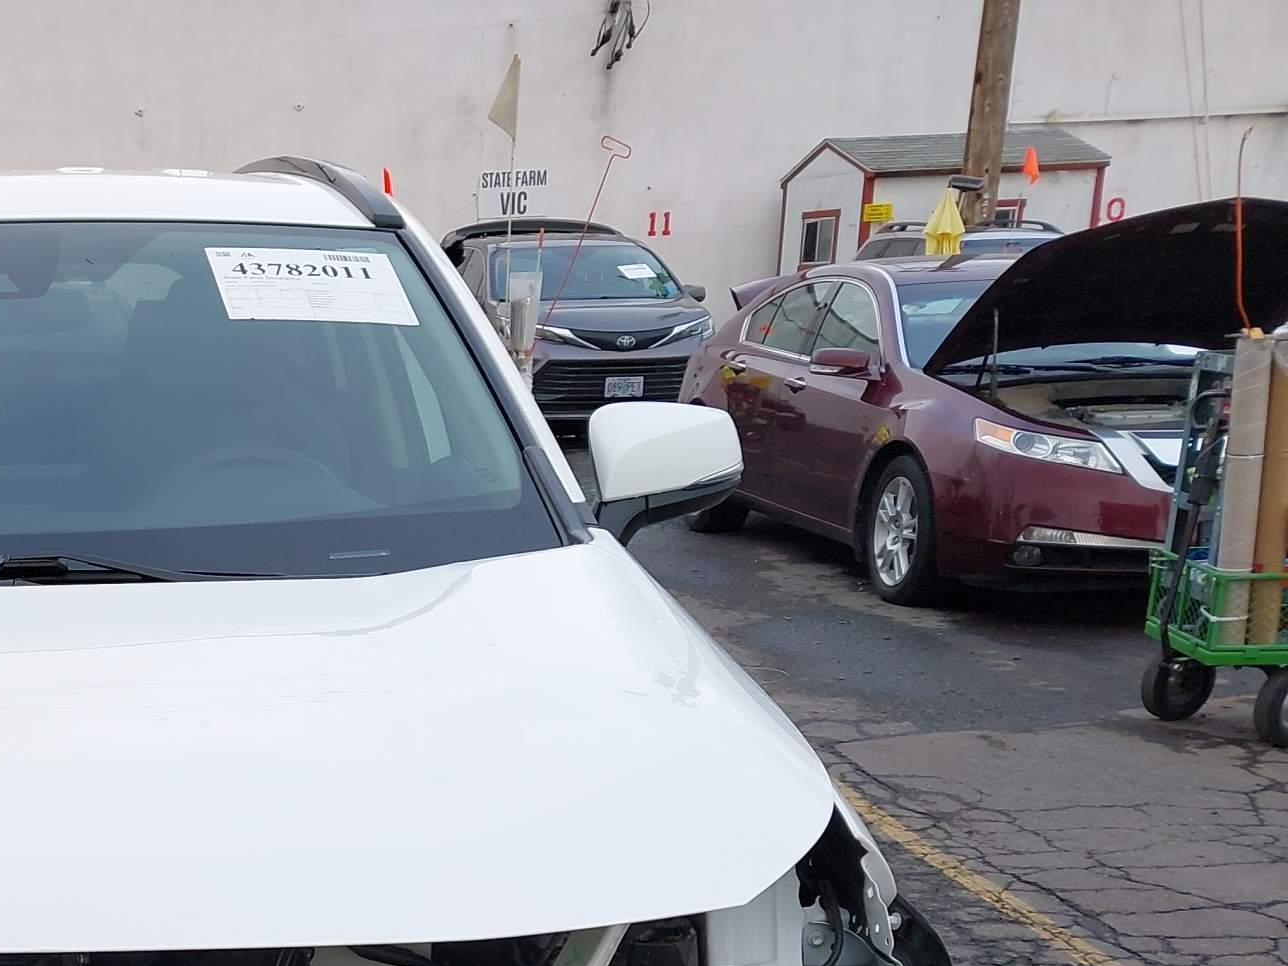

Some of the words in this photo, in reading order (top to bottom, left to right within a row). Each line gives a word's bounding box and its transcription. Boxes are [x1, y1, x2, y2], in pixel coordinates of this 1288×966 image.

[481, 171, 512, 188] STATE
[515, 169, 548, 187] FARM
[500, 191, 528, 215] VIC
[647, 211, 671, 236] 11
[231, 262, 373, 280] 43782011
